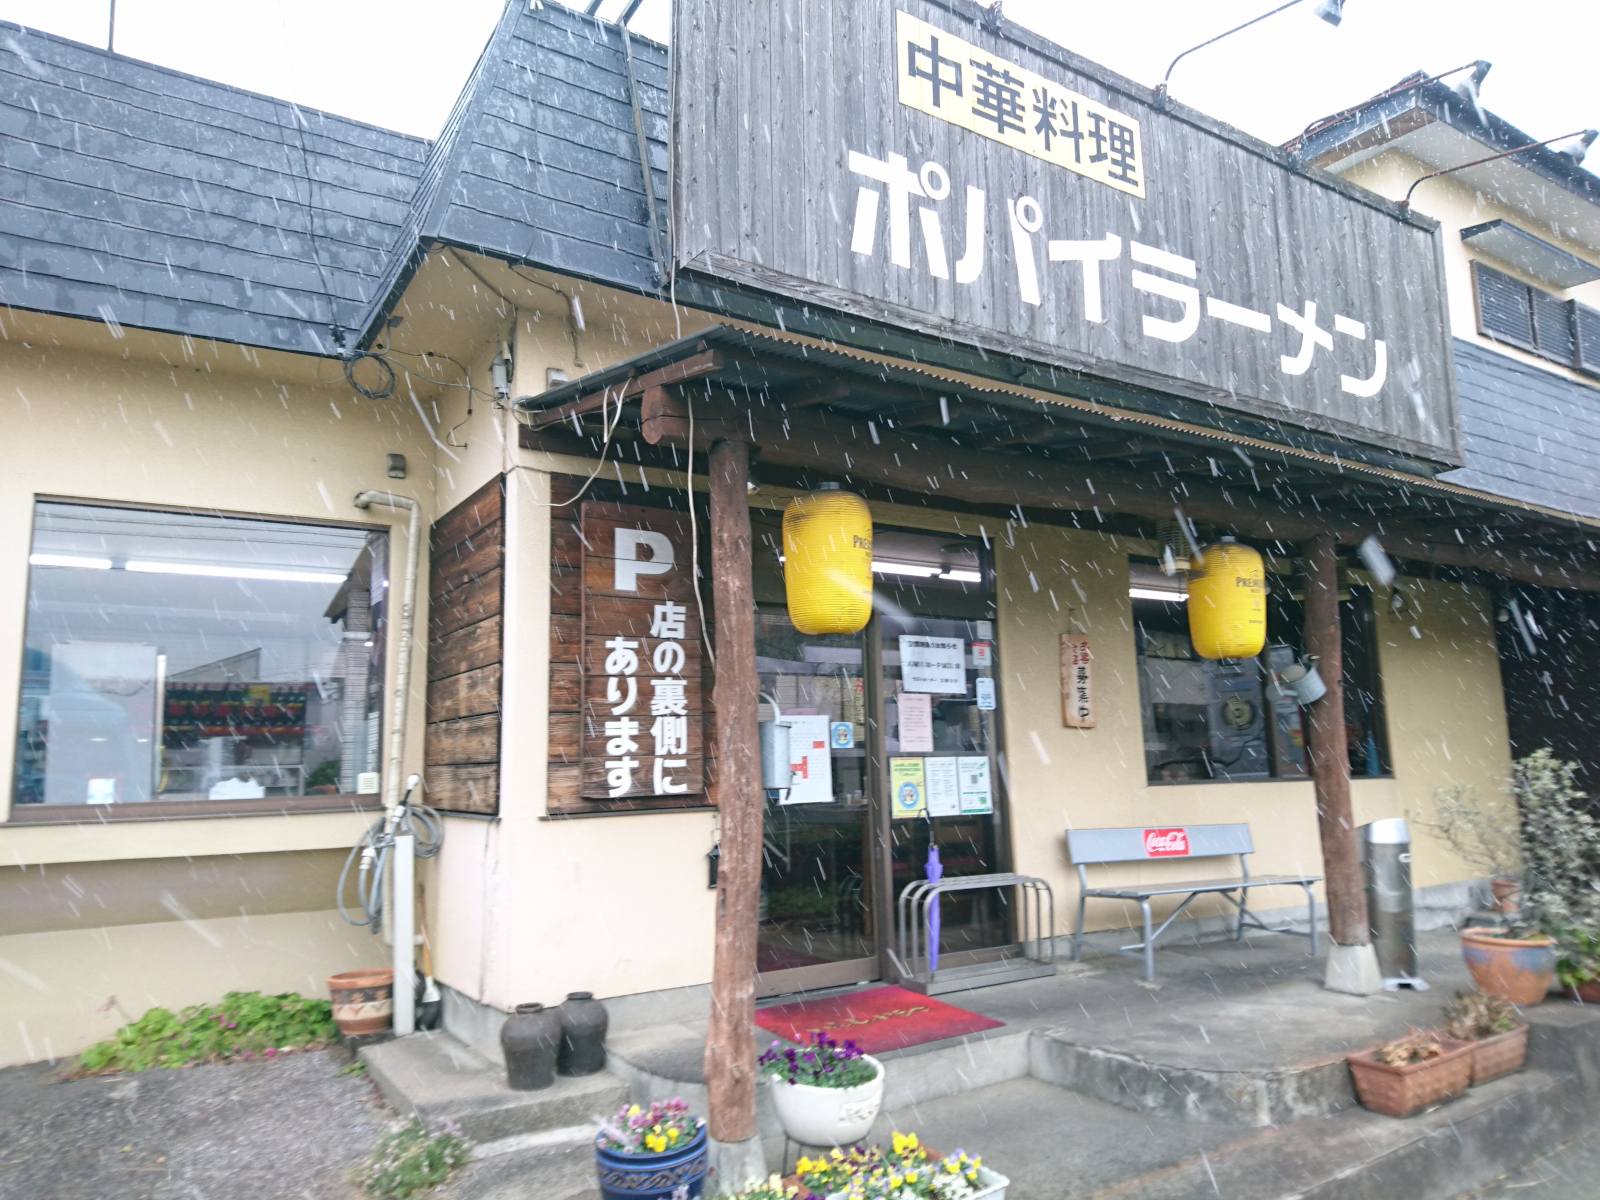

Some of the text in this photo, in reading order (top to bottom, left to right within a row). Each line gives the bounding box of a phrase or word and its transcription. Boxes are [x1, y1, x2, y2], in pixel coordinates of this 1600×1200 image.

[907, 35, 1139, 188] 中華料理
[848, 150, 1387, 397] ポパイラーメン
[614, 527, 675, 592] P
[604, 636, 640, 798] あります
[650, 601, 688, 795] 店の裏側に
